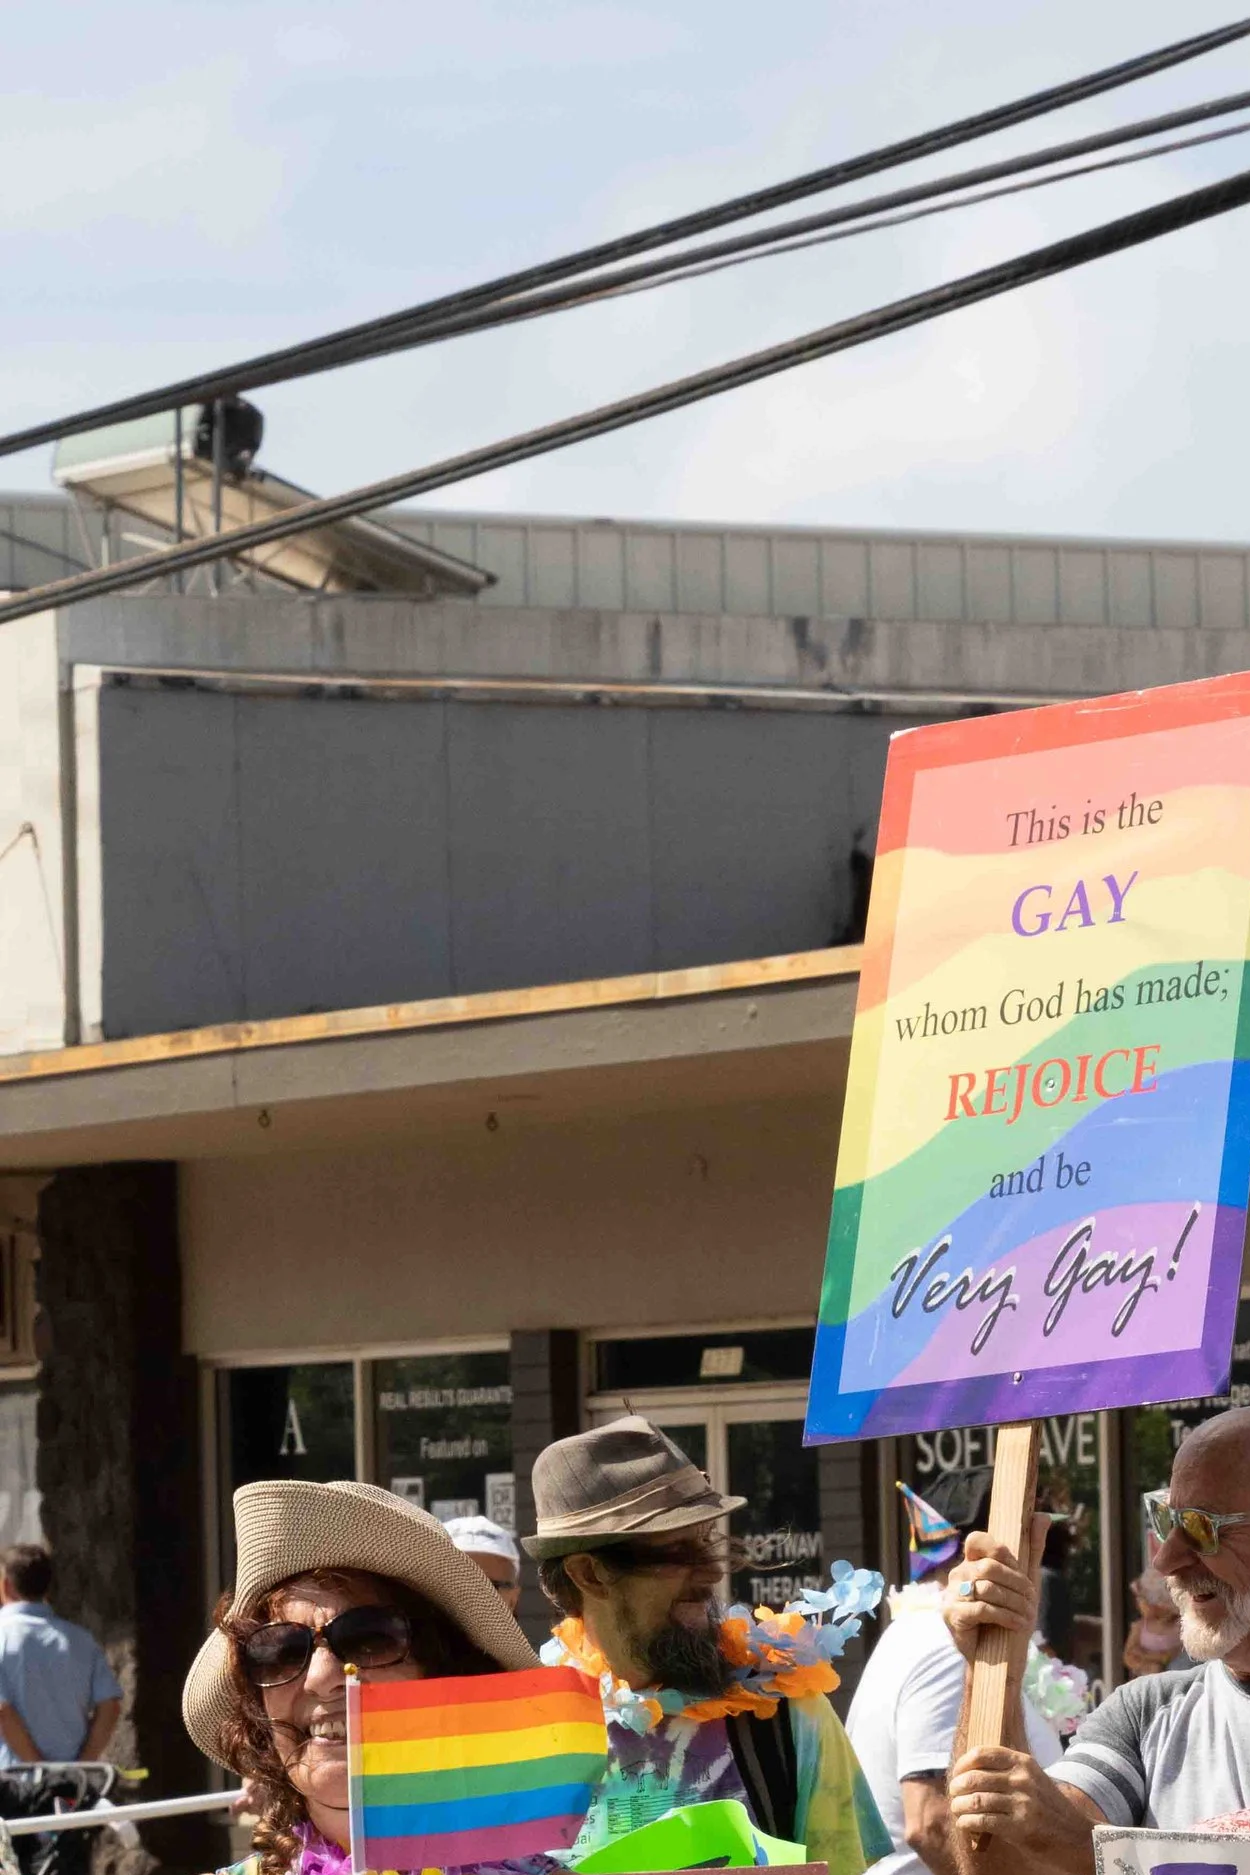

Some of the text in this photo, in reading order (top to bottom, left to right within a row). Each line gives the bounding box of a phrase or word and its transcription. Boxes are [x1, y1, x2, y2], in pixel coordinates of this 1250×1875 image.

[1006, 791, 1164, 847] This is the
[1011, 870, 1139, 938] GAY
[895, 960, 1231, 1042] whom God has made;
[942, 1044, 1161, 1126] REJOICE
[989, 1152, 1092, 1200] and be
[890, 1200, 1201, 1357] Very Gay!
[915, 1412, 1097, 1473] SOFTAVE
